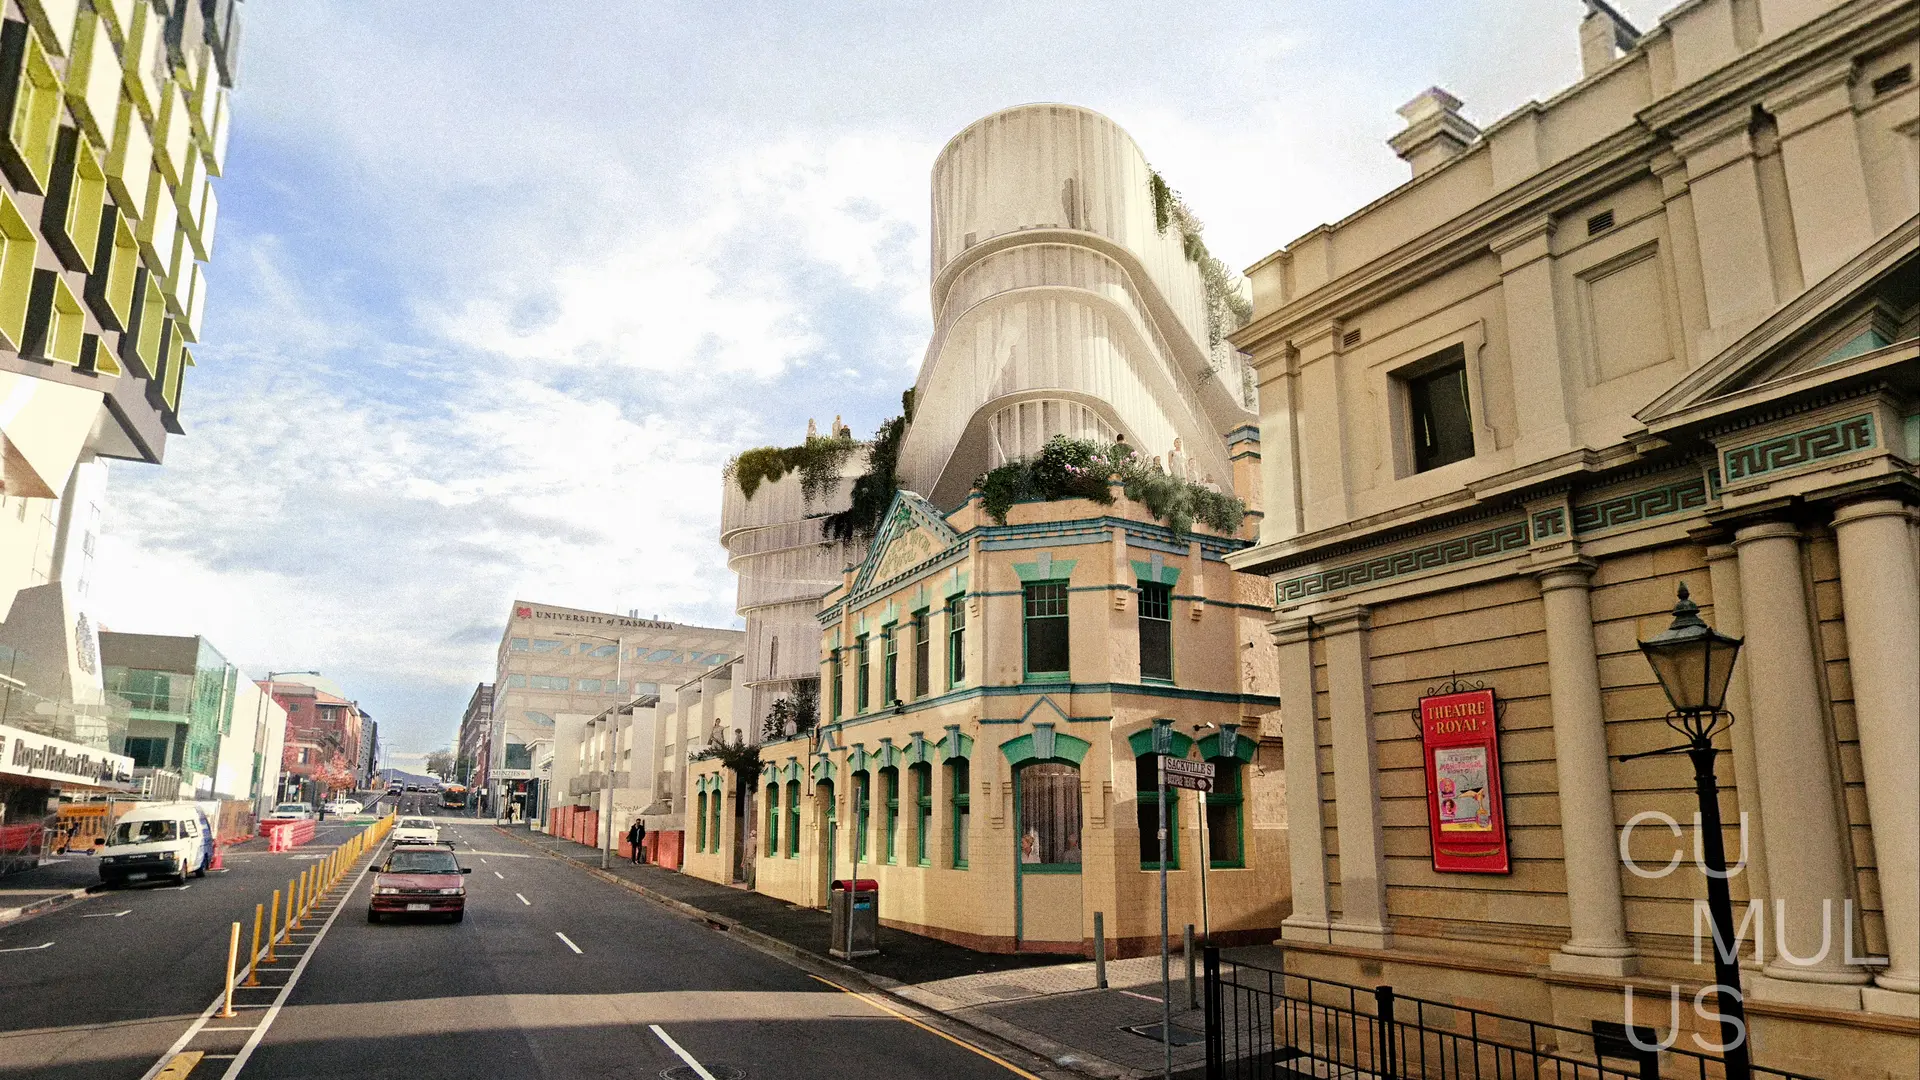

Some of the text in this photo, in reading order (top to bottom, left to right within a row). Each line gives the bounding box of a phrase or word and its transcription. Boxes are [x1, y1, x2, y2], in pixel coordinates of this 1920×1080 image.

[536, 611, 674, 630] UNIVERSITY of TASMANIA
[1427, 701, 1485, 720] THEATRE
[1436, 718, 1480, 734] ROYAL
[12, 738, 47, 773] Royal
[45, 745, 82, 776] Hobart
[1168, 759, 1205, 774] SACKVILLE
